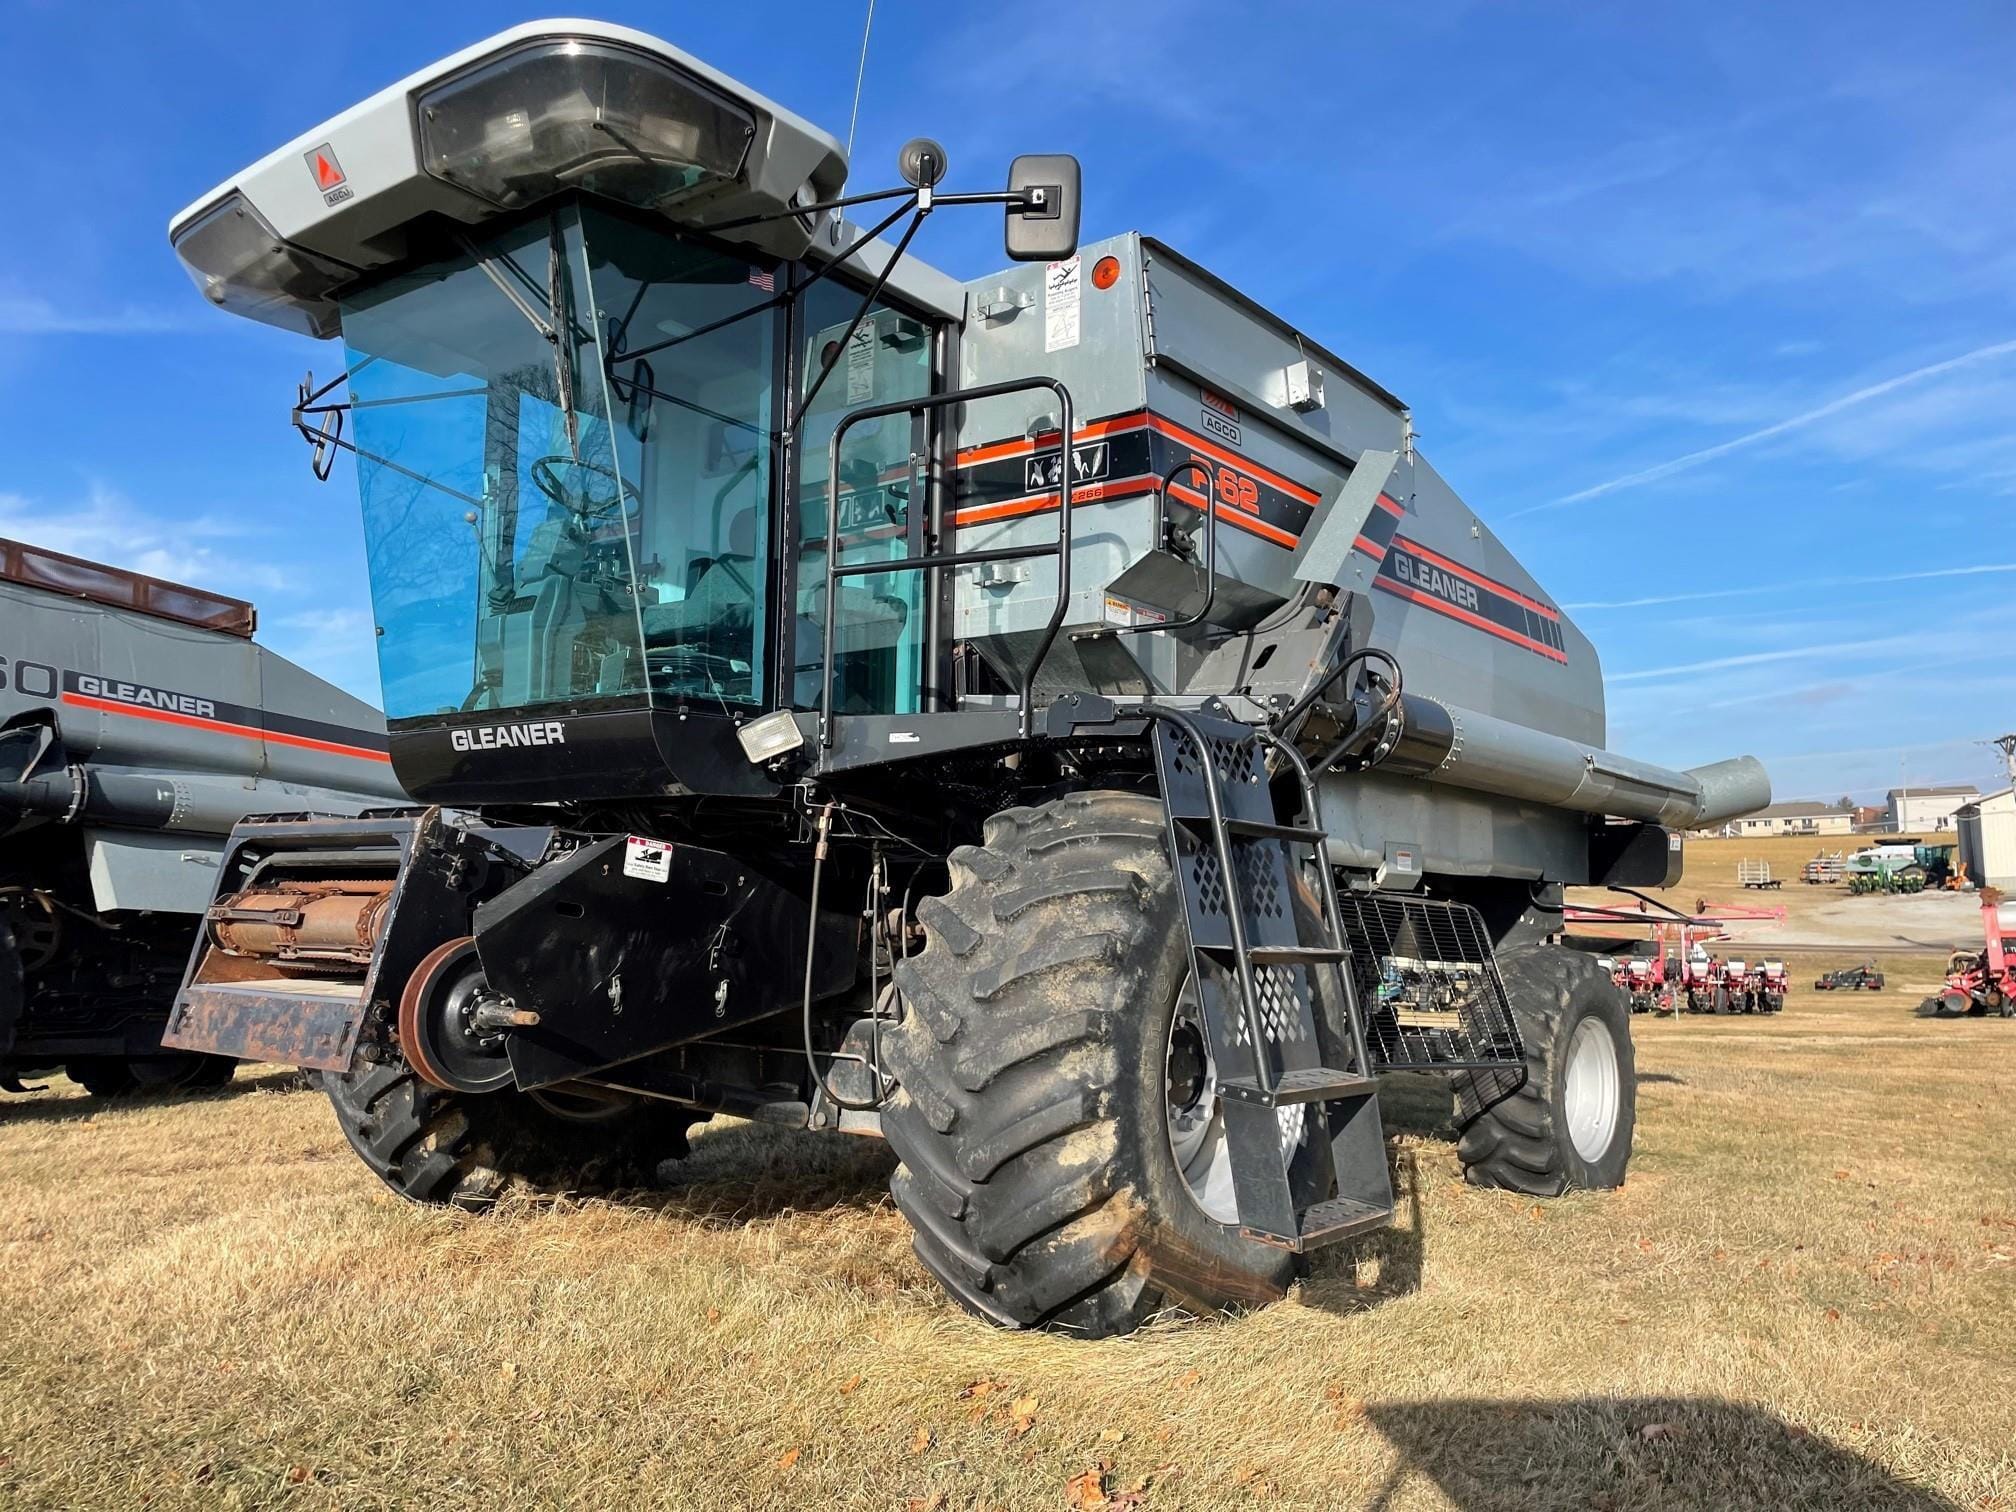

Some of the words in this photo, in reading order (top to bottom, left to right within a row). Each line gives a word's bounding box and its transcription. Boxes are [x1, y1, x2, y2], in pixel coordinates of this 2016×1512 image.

[328, 188, 350, 203] AGCO
[1206, 417, 1237, 440] AGCO
[1394, 552, 1478, 611] GLEANER
[0, 655, 58, 700] 0
[78, 676, 215, 718] GLEANER
[451, 721, 565, 751] GLEANER
